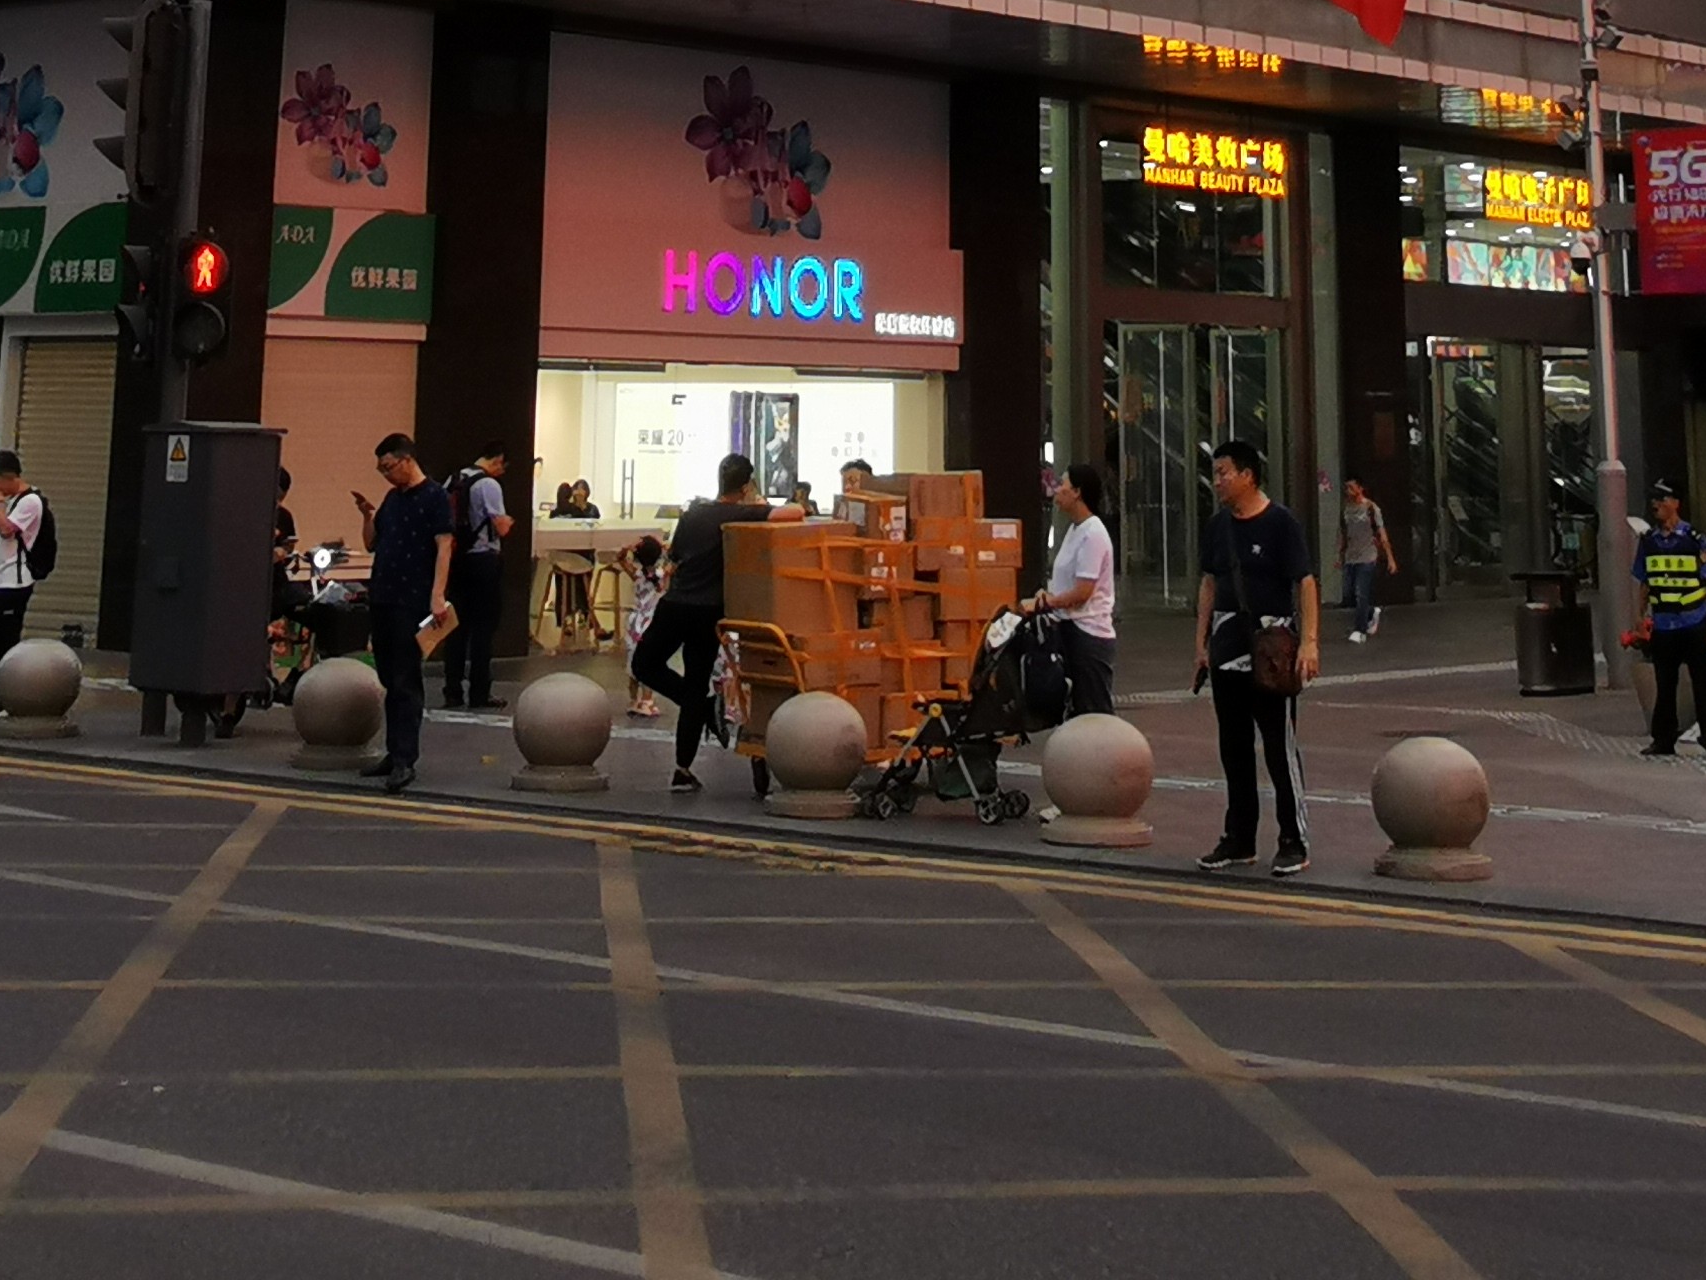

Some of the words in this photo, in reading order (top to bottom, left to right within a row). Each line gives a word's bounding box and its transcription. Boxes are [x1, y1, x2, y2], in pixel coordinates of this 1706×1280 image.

[1248, 176, 1285, 197] PLAZA
[1565, 210, 1591, 228] PLAZ
[662, 248, 864, 323] HONOR
